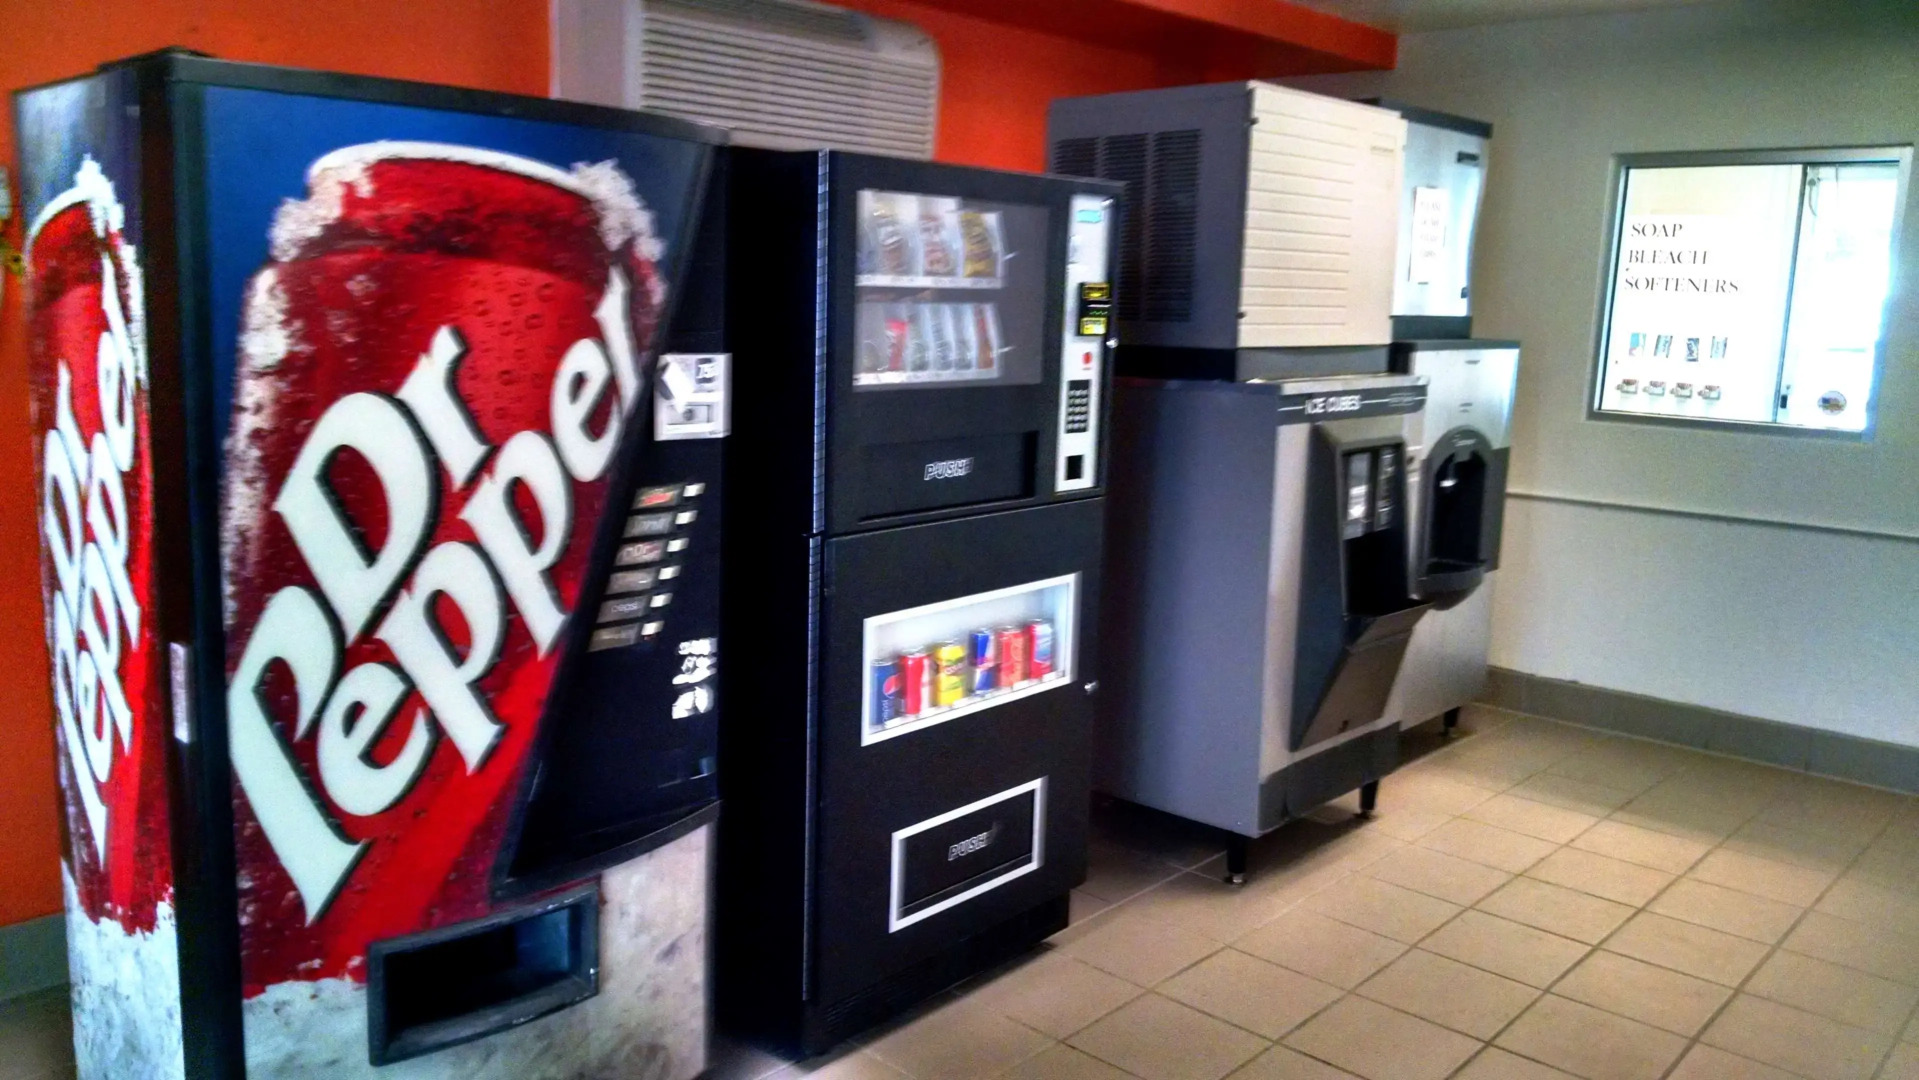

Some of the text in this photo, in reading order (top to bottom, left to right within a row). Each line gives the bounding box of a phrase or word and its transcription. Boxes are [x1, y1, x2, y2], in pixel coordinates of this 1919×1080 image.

[1631, 223, 1683, 237] SOAP
[1628, 249, 1707, 264] BLEACH
[1625, 276, 1740, 293] SOFTENERS
[1305, 395, 1361, 414] ICE CUBES
[924, 458, 973, 480] PUSH
[272, 326, 495, 641] Dr
[44, 358, 90, 634] Dr
[948, 829, 990, 861] PUSH
